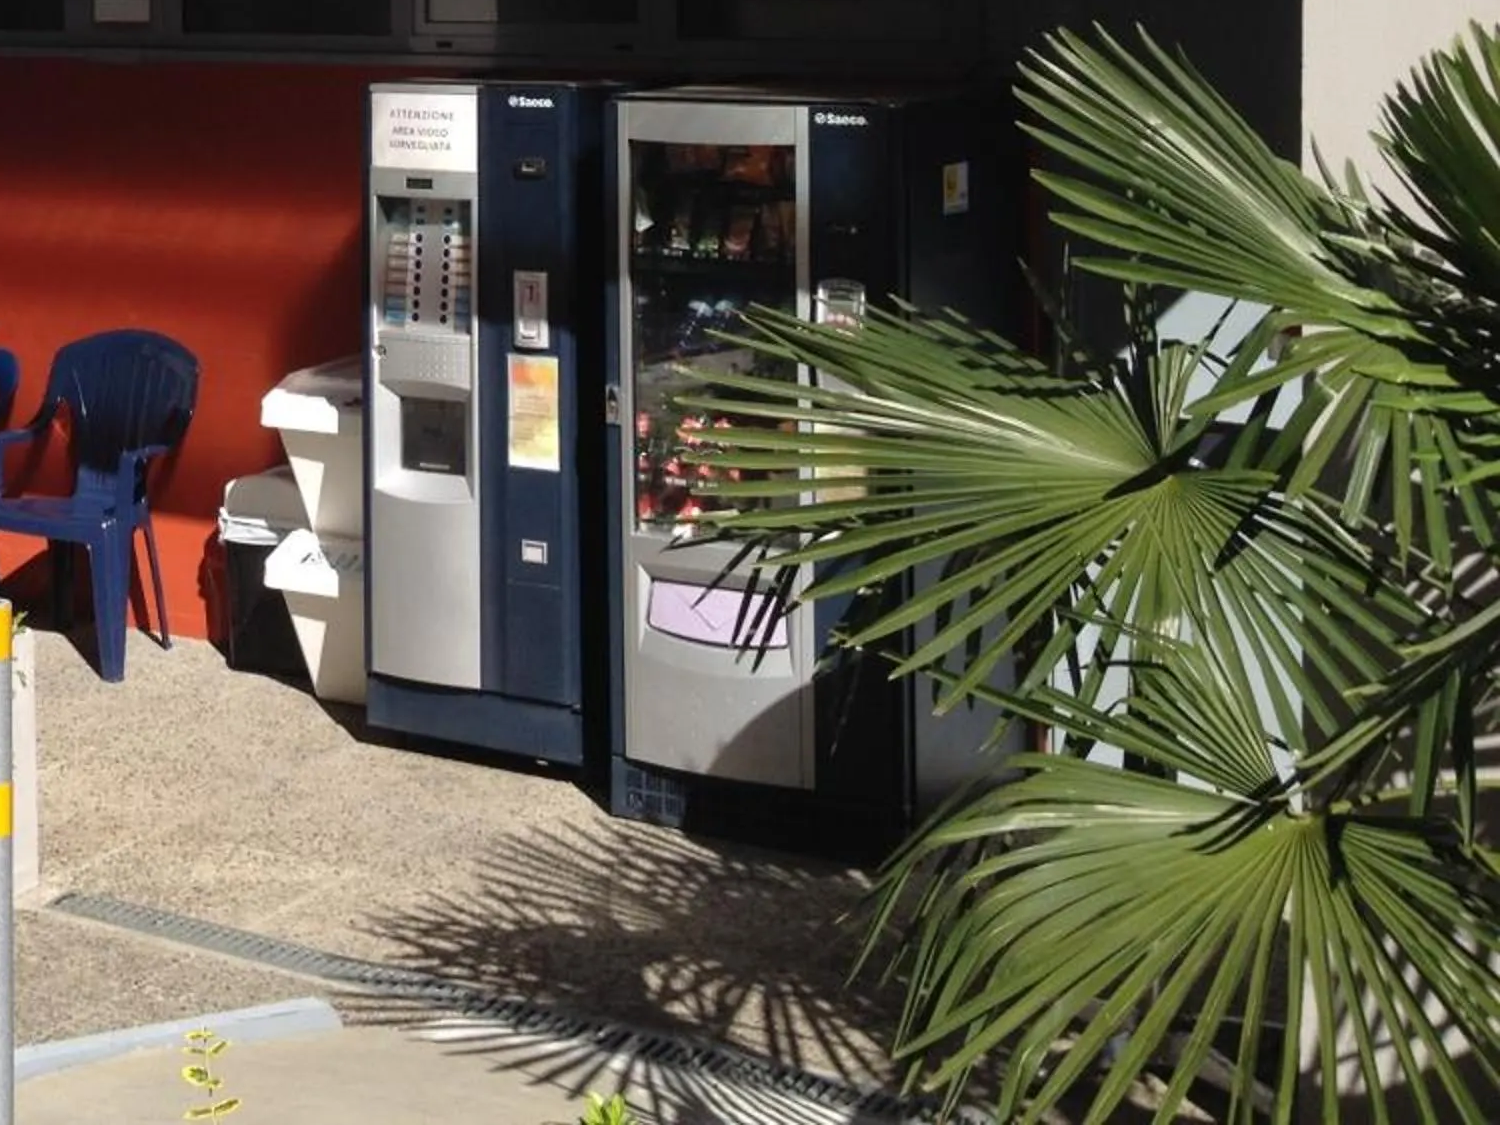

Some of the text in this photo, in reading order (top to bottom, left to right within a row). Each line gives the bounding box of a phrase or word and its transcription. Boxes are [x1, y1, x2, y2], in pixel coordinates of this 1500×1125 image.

[519, 96, 553, 107] Saeco
[389, 108, 454, 121] ATTENZIONE
[827, 112, 867, 125] Saeco
[417, 127, 449, 138] VIDEO
